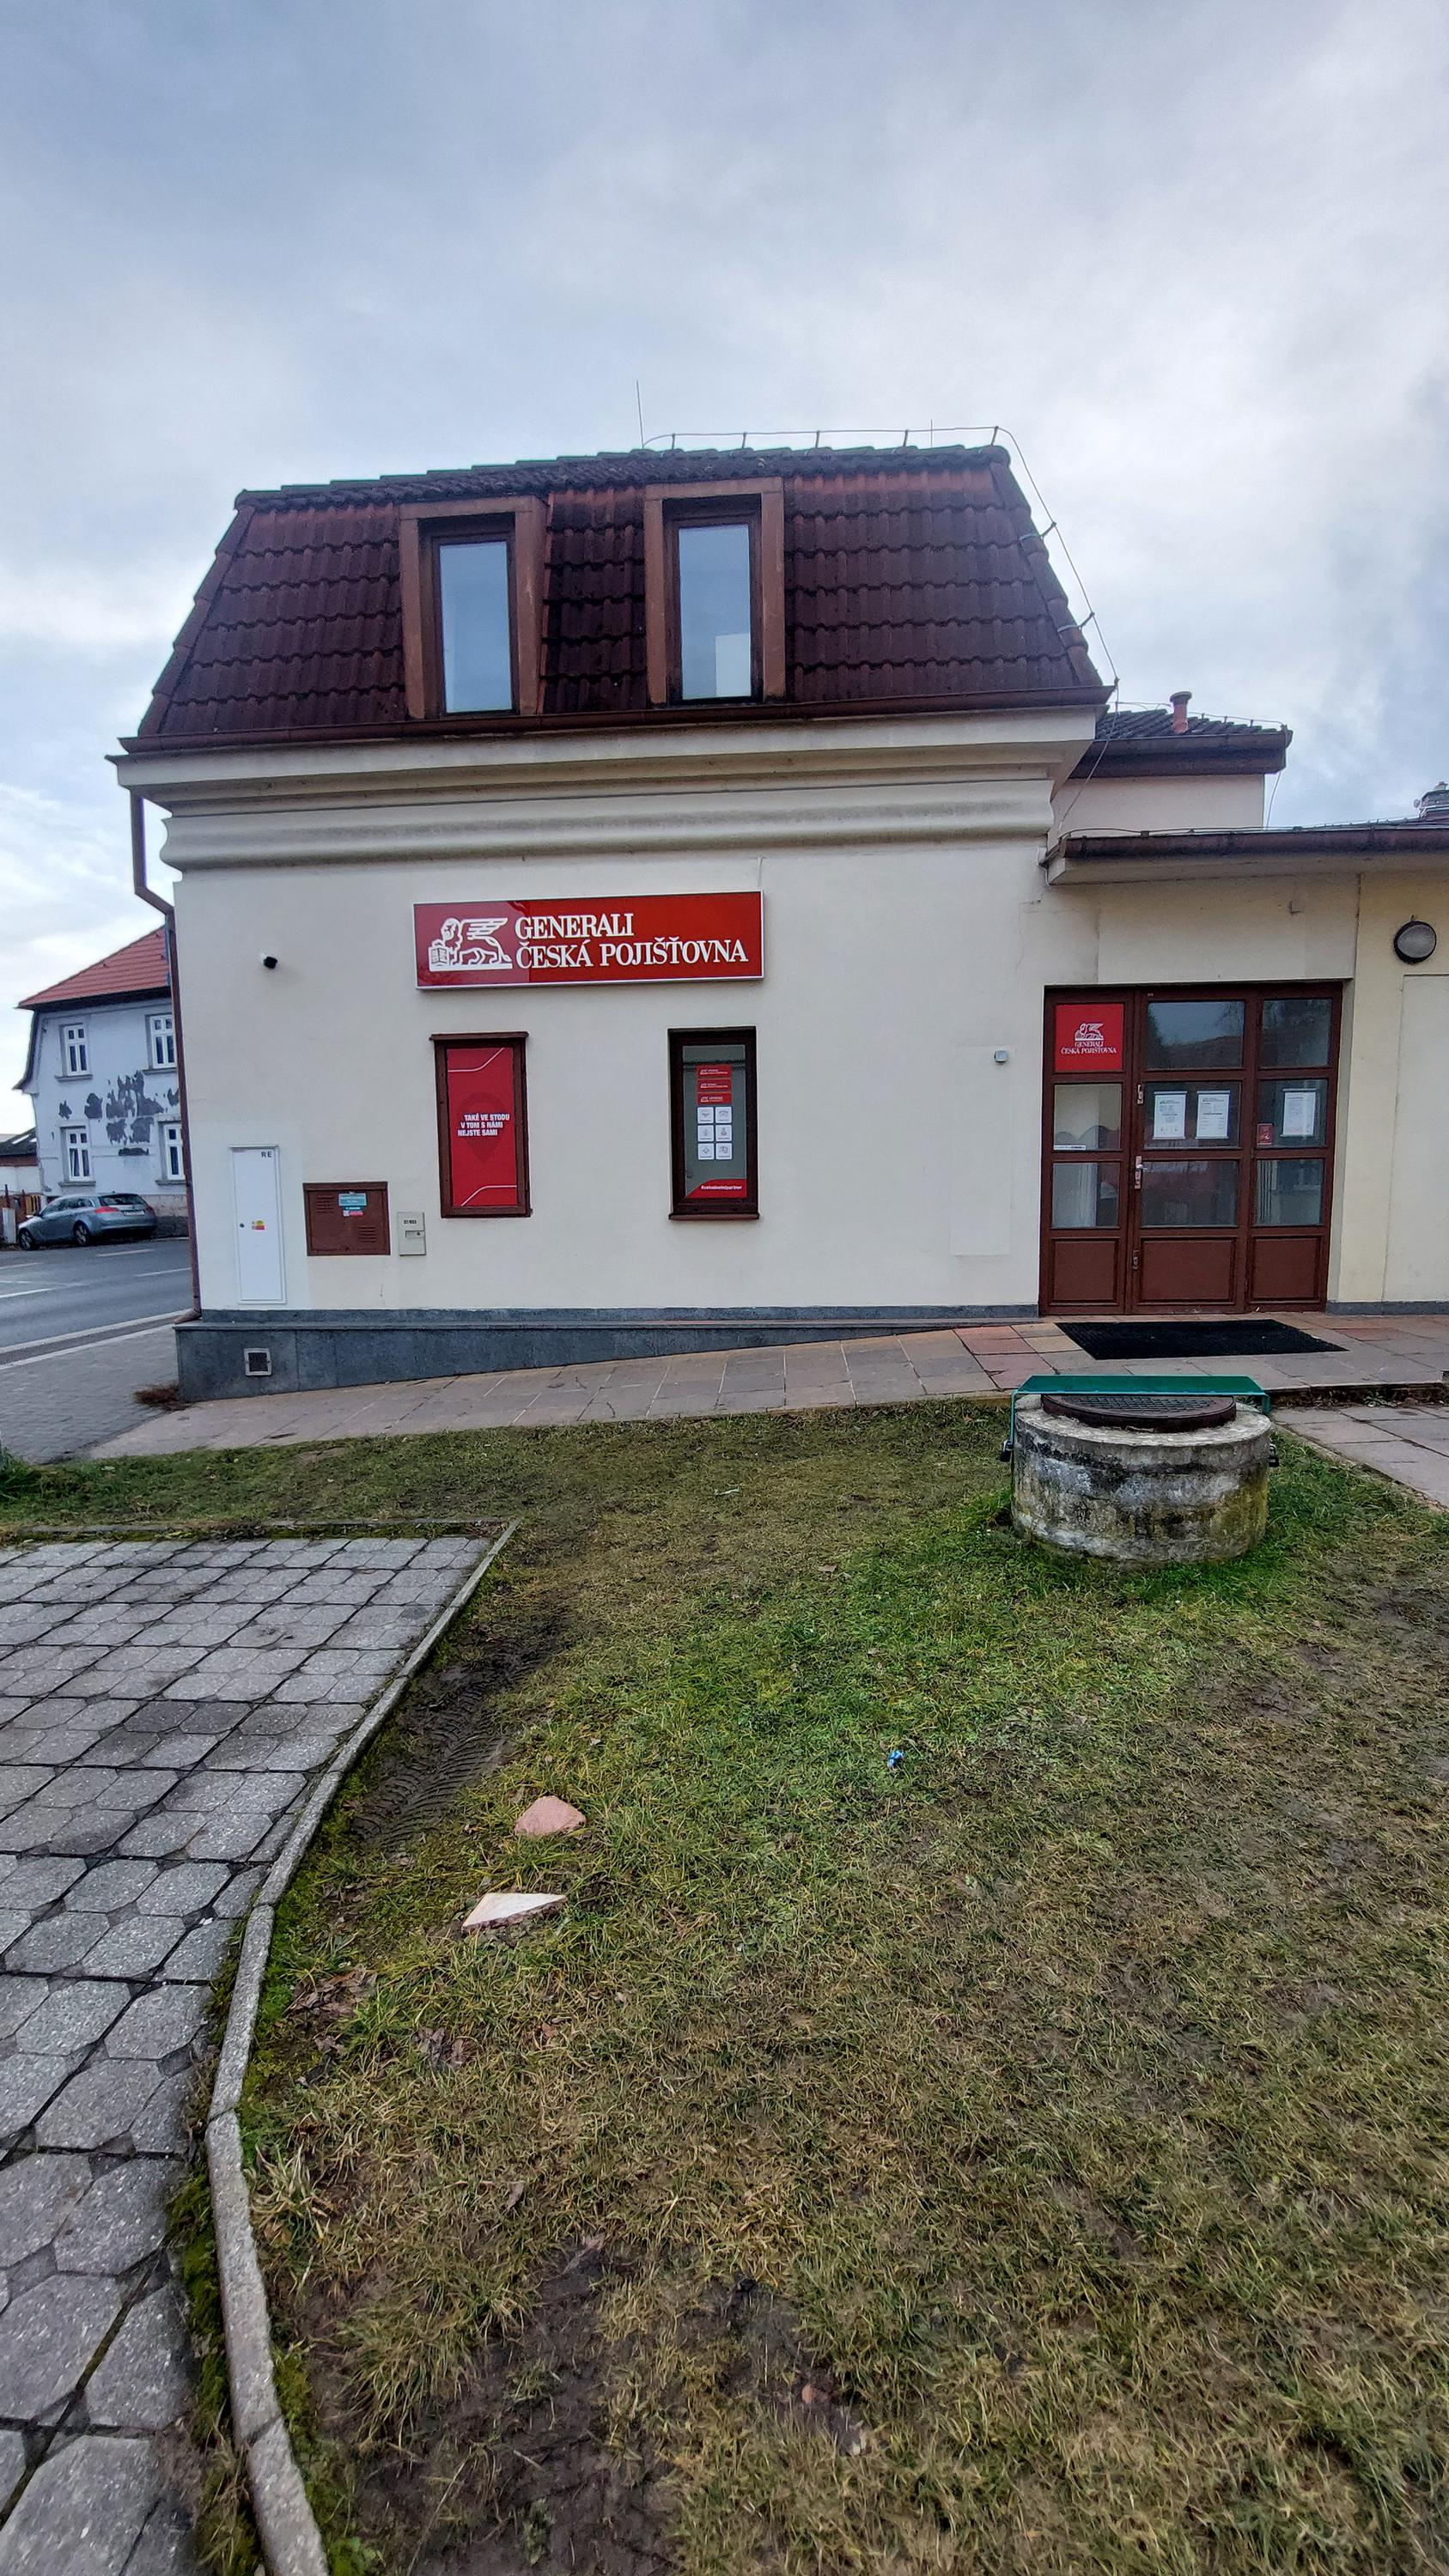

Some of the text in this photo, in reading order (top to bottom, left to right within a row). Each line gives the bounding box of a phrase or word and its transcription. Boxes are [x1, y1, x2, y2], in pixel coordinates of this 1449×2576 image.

[514, 913, 635, 940] GENERALI
[515, 936, 749, 969] ČESKÁ POJIŠŤOVNA
